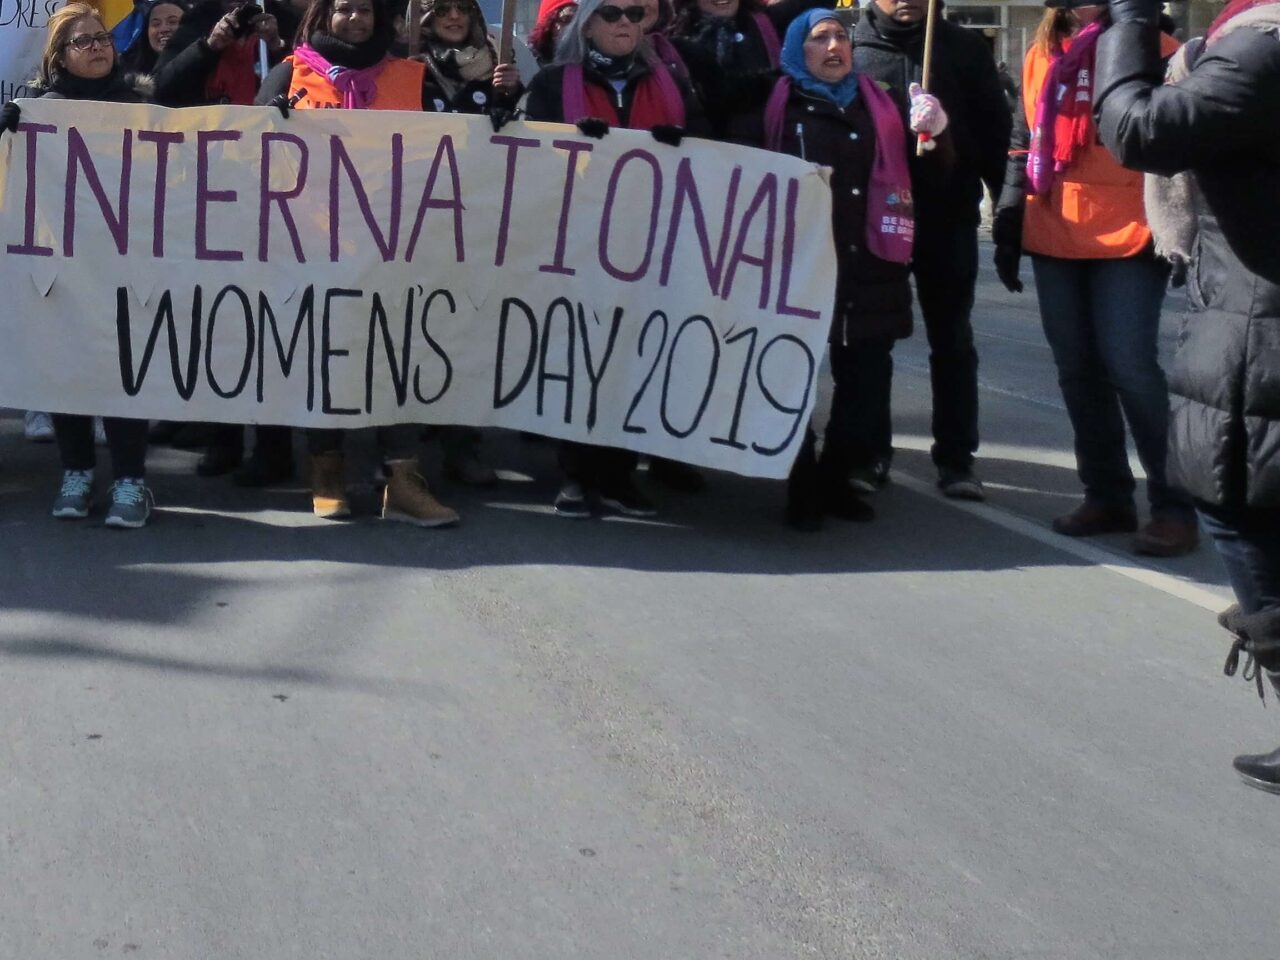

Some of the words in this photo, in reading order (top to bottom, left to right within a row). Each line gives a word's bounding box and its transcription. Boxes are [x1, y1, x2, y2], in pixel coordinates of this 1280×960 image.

[6, 122, 822, 320] INTERNATIONAL
[116, 283, 456, 416] WOMEN'S
[493, 295, 624, 432] DAY
[622, 309, 816, 456] 2019
